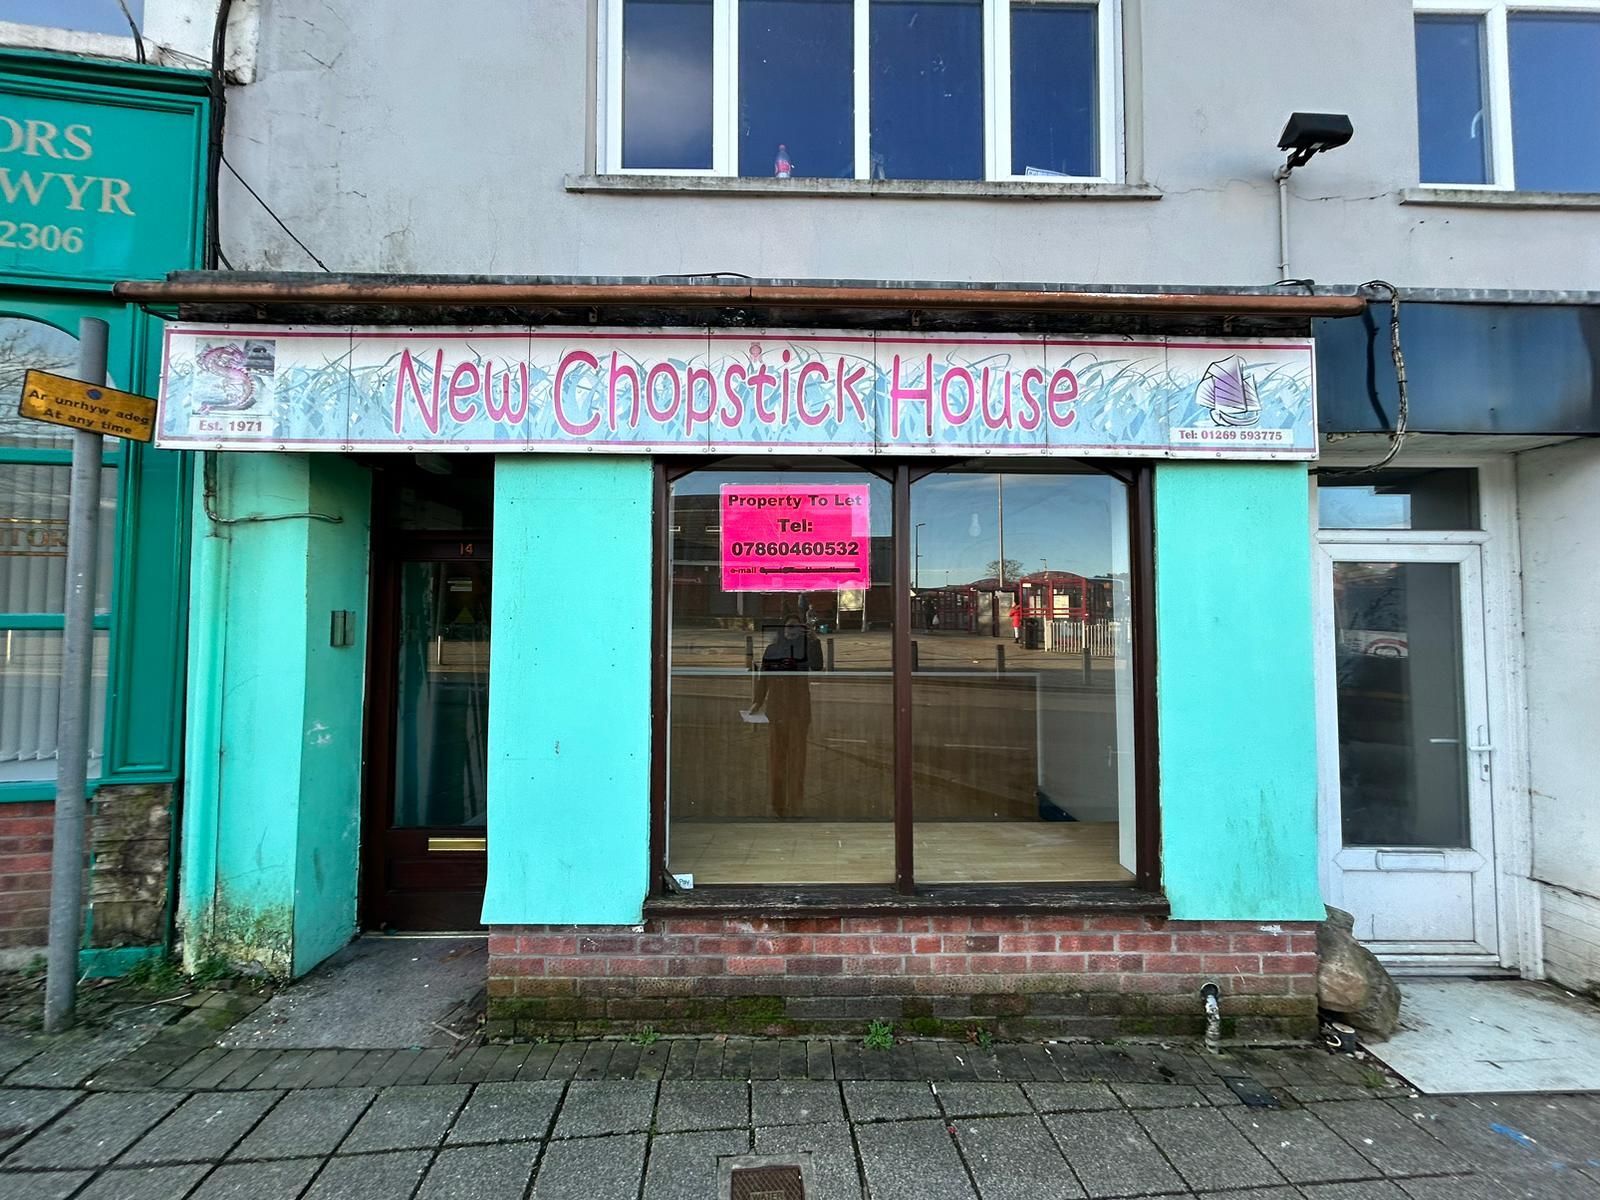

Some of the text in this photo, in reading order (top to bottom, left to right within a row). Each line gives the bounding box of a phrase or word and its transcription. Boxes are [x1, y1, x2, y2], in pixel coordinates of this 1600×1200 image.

[0, 220, 84, 254] 2306
[393, 347, 1079, 438] New Chopstick House
[28, 390, 149, 425] Ar unrhyw adeg
[43, 408, 132, 433] At any time
[200, 420, 263, 432] Est. 1971
[1178, 429, 1282, 441] Tel: 01269 593775
[728, 494, 862, 508] Property To Let
[777, 518, 813, 532] Tel:
[731, 541, 860, 556] 07860460532
[730, 566, 757, 574] e-mail
